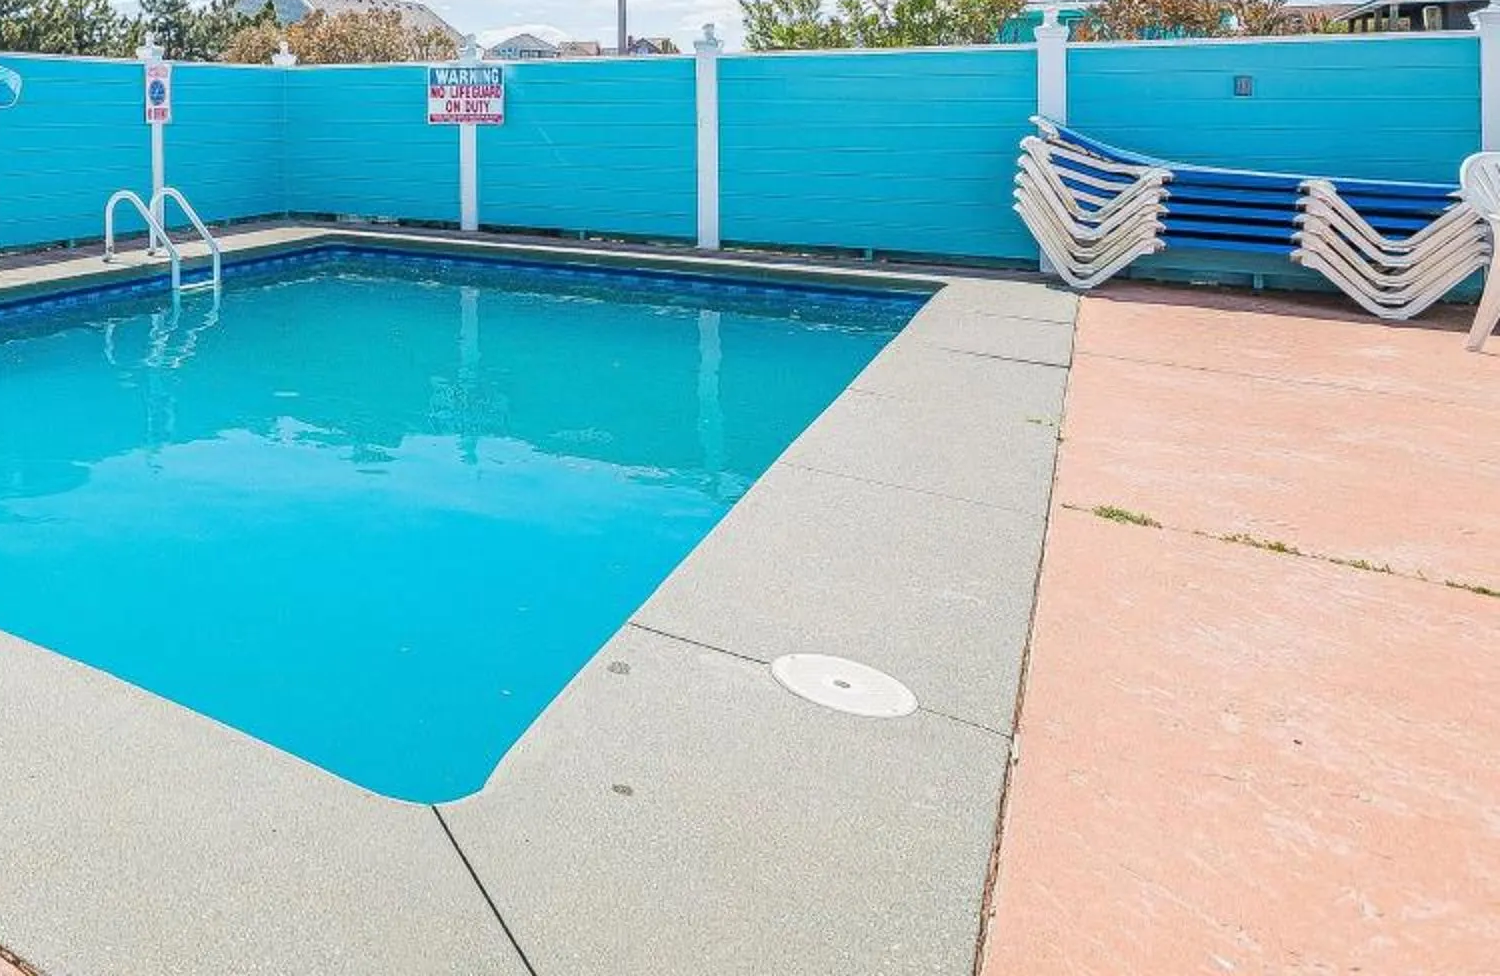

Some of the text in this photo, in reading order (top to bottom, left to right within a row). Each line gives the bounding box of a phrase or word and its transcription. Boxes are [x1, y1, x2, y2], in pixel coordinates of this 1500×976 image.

[435, 68, 499, 85] WARNNG
[431, 86, 501, 99] NO LIFEGUARD
[445, 100, 490, 113] ON DUTY
